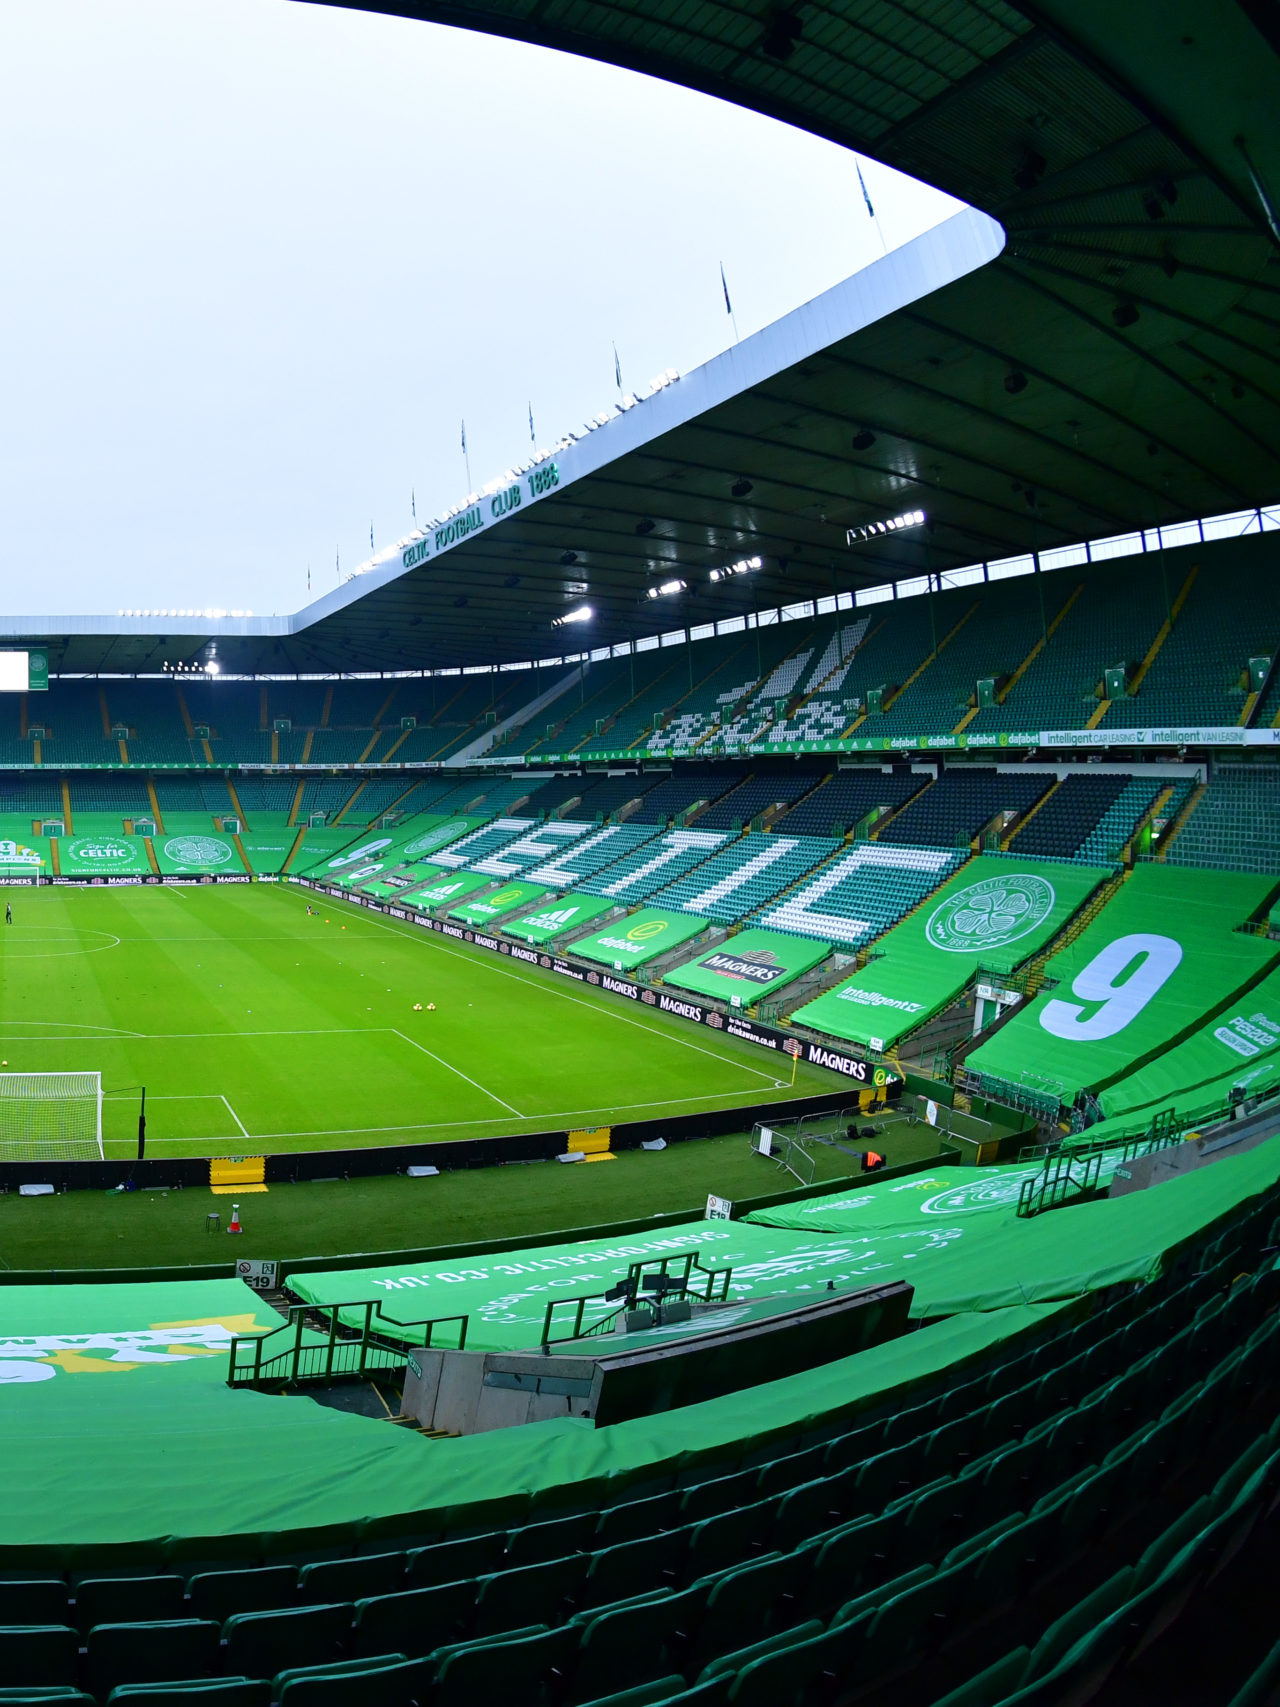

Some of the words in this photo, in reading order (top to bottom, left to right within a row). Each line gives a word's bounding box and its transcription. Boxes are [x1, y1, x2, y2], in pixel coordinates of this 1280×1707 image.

[402, 538, 430, 568] CELTIC
[435, 507, 484, 550] FOOTBALL
[491, 485, 521, 517] CLUB
[528, 463, 560, 497] 1888
[891, 738, 917, 749] dafabet
[928, 737, 955, 748] dafabet
[967, 734, 996, 746] dafabet
[1009, 733, 1039, 745] dafabet
[1048, 733, 1093, 746] intelligent
[1152, 731, 1200, 744] intelligent
[79, 849, 127, 857] CELTIC
[258, 875, 279, 883] dafabet
[422, 818, 953, 941] CELTIC
[969, 879, 1007, 896] CELTIC
[1007, 878, 1049, 901] FOOTBALL
[390, 907, 406, 919] MAGNERS
[414, 915, 433, 929] MAGNERS
[522, 916, 563, 931] adidas
[442, 924, 463, 939] MAGNERS
[474, 934, 498, 951] MAGNERS
[597, 935, 647, 954] dafabet
[511, 946, 538, 964] MAGNERS
[705, 954, 780, 980] MAGNERS
[602, 976, 638, 1000] MAGNERS
[1039, 933, 1183, 1041] 9
[841, 985, 910, 1012] Intelligent
[660, 995, 702, 1022] MAGNERS
[727, 1024, 777, 1049] drinkaware.co.uk
[809, 1045, 866, 1081] MAGNERS
[373, 1230, 730, 1291] SIGNFORCELTIC.CO.UK
[242, 1275, 271, 1288] E19
